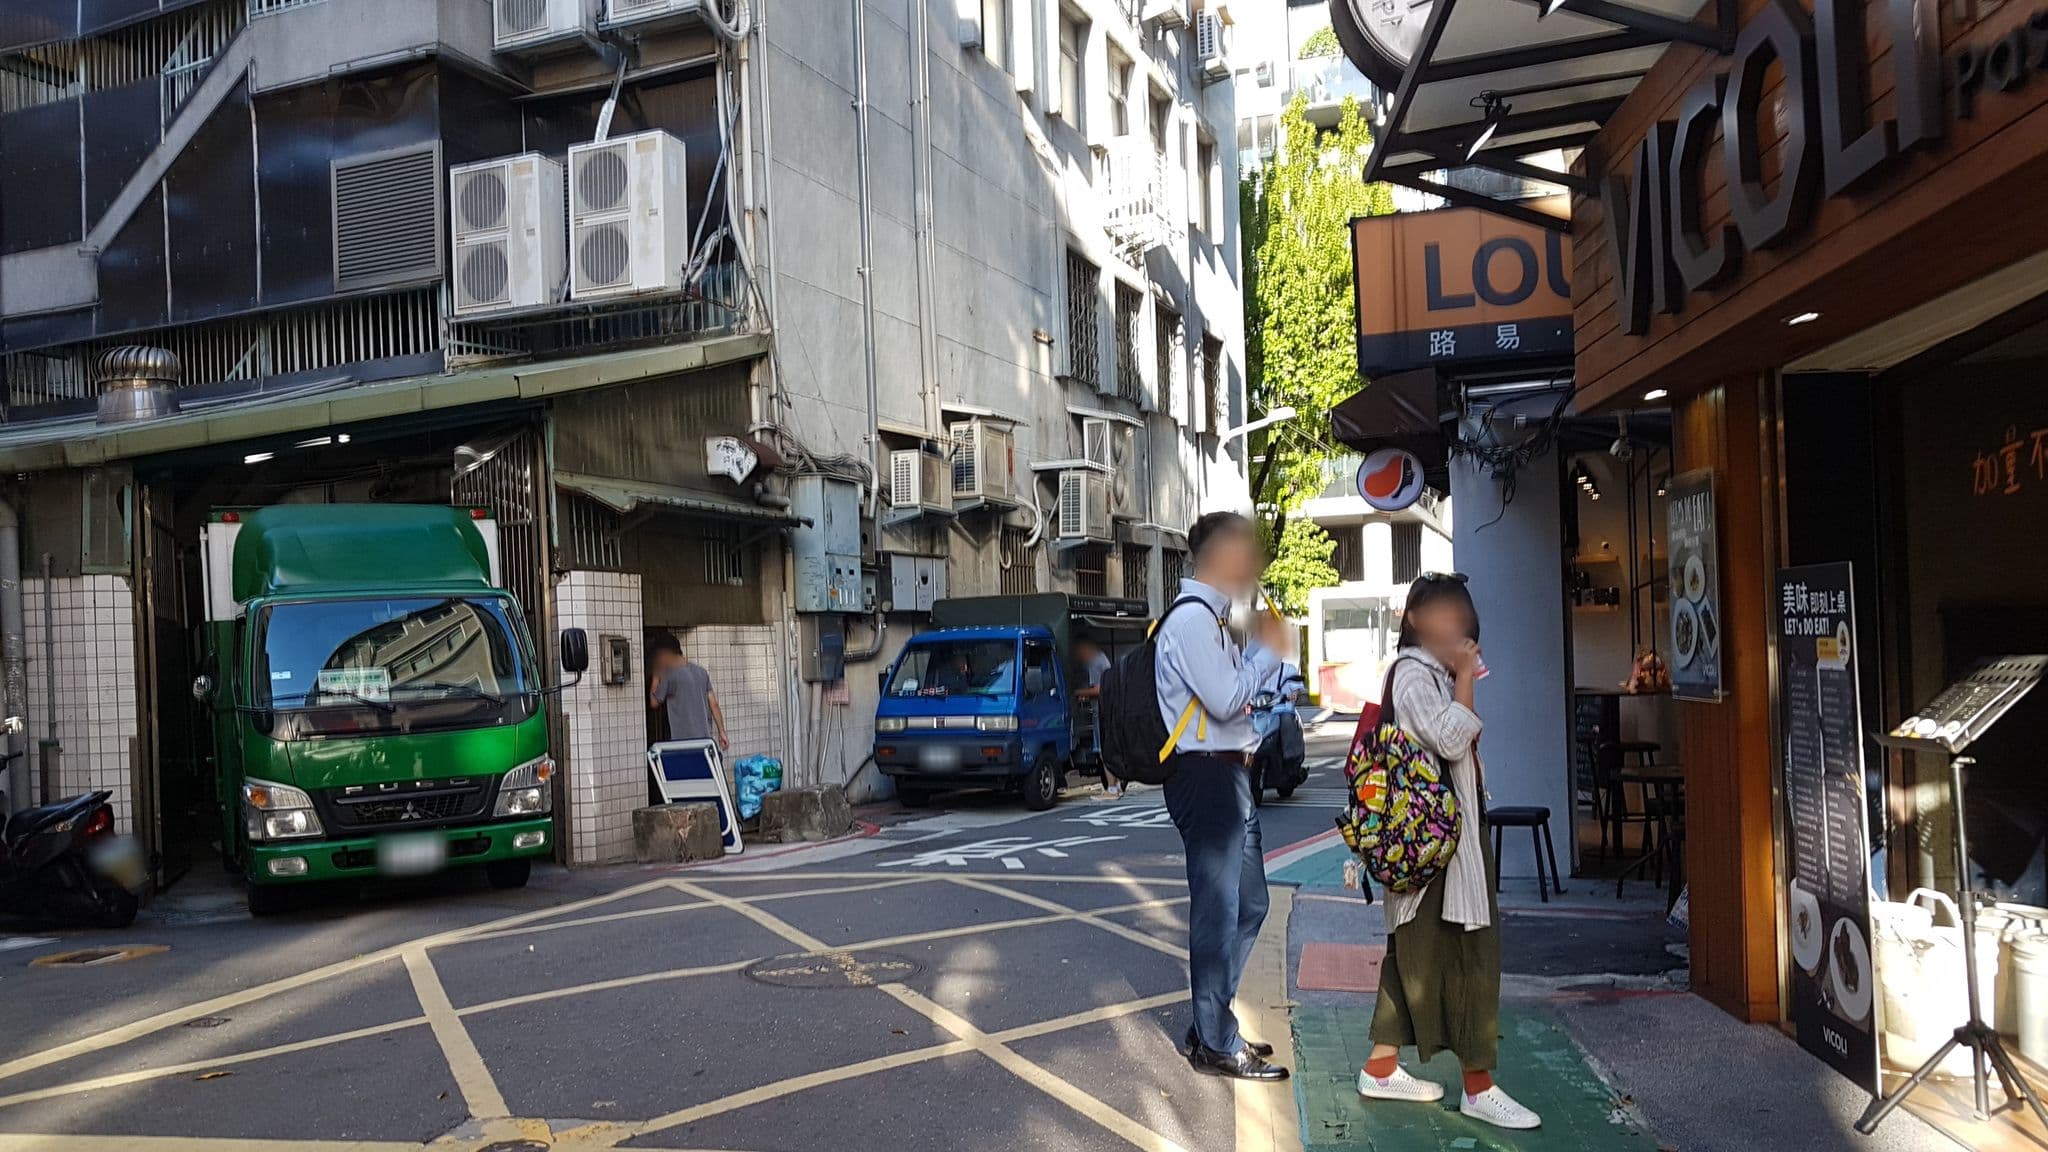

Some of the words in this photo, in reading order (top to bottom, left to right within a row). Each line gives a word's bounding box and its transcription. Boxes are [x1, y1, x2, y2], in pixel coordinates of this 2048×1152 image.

[1429, 324, 1520, 357] 路易
[1783, 581, 1809, 615] 美味
[1810, 589, 1846, 614] 即刻上桌
[1803, 617, 1813, 635] DO
[1814, 616, 1829, 635] EAT!
[1823, 1025, 1848, 1056] VICOLI
